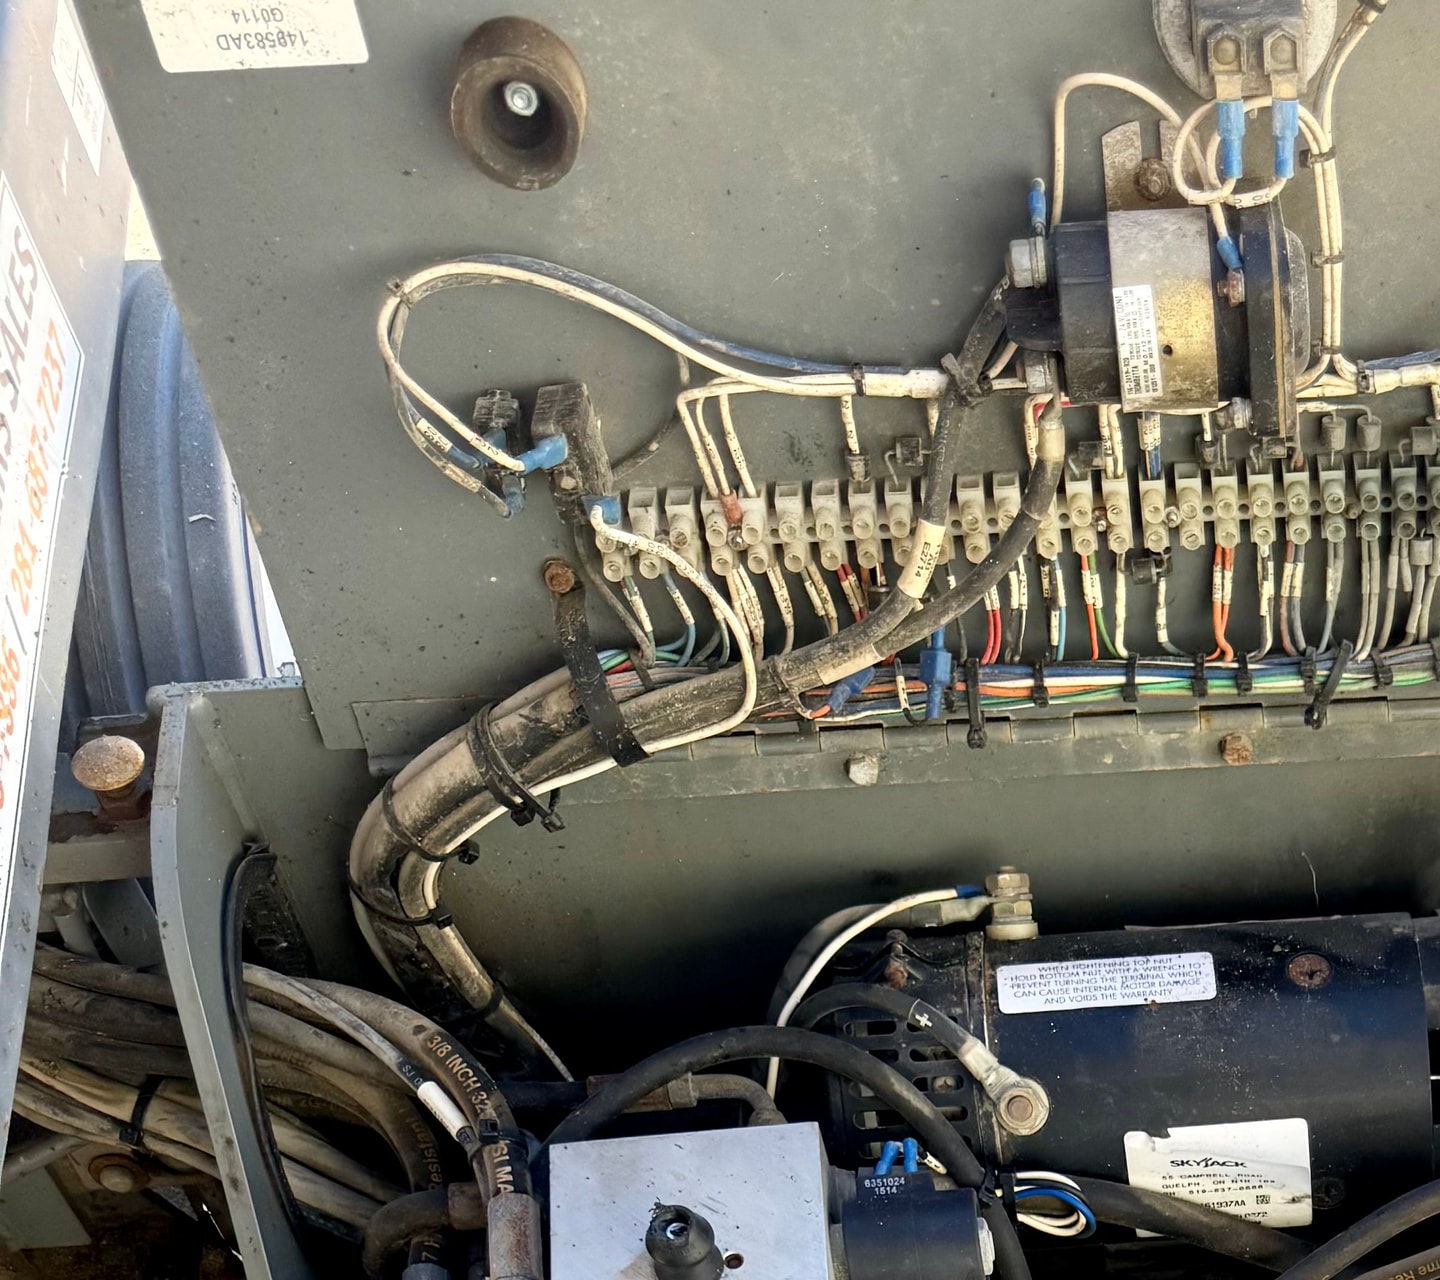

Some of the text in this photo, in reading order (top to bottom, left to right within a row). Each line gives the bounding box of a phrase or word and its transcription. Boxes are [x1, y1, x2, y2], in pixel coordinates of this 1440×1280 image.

[231, 7, 284, 24] G0114
[915, 541, 931, 577] E2714
[1010, 974, 1037, 983] HOLD
[1039, 971, 1080, 981] BOTTOM
[1142, 963, 1187, 973] WRENCH
[1038, 964, 1070, 973] WHEN
[1153, 957, 1173, 965] NUT
[1009, 970, 1202, 989] PREVENT TURNING THE TERMINAL WHICH
[1013, 978, 1201, 998] CAN CAUSE INTERNAL MOTOR DAMAGE
[1044, 988, 1173, 1005] AND VOIDS THE WARRANTY
[426, 1035, 452, 1058] 3/8
[445, 1053, 482, 1093] INCH
[493, 1139, 510, 1163] SI
[1169, 1157, 1248, 1169] SKYJACK
[495, 1165, 516, 1194] MA
[864, 1176, 906, 1188] 6351024
[1179, 1172, 1231, 1180] CAMPBELL
[874, 1186, 898, 1195] 1514
